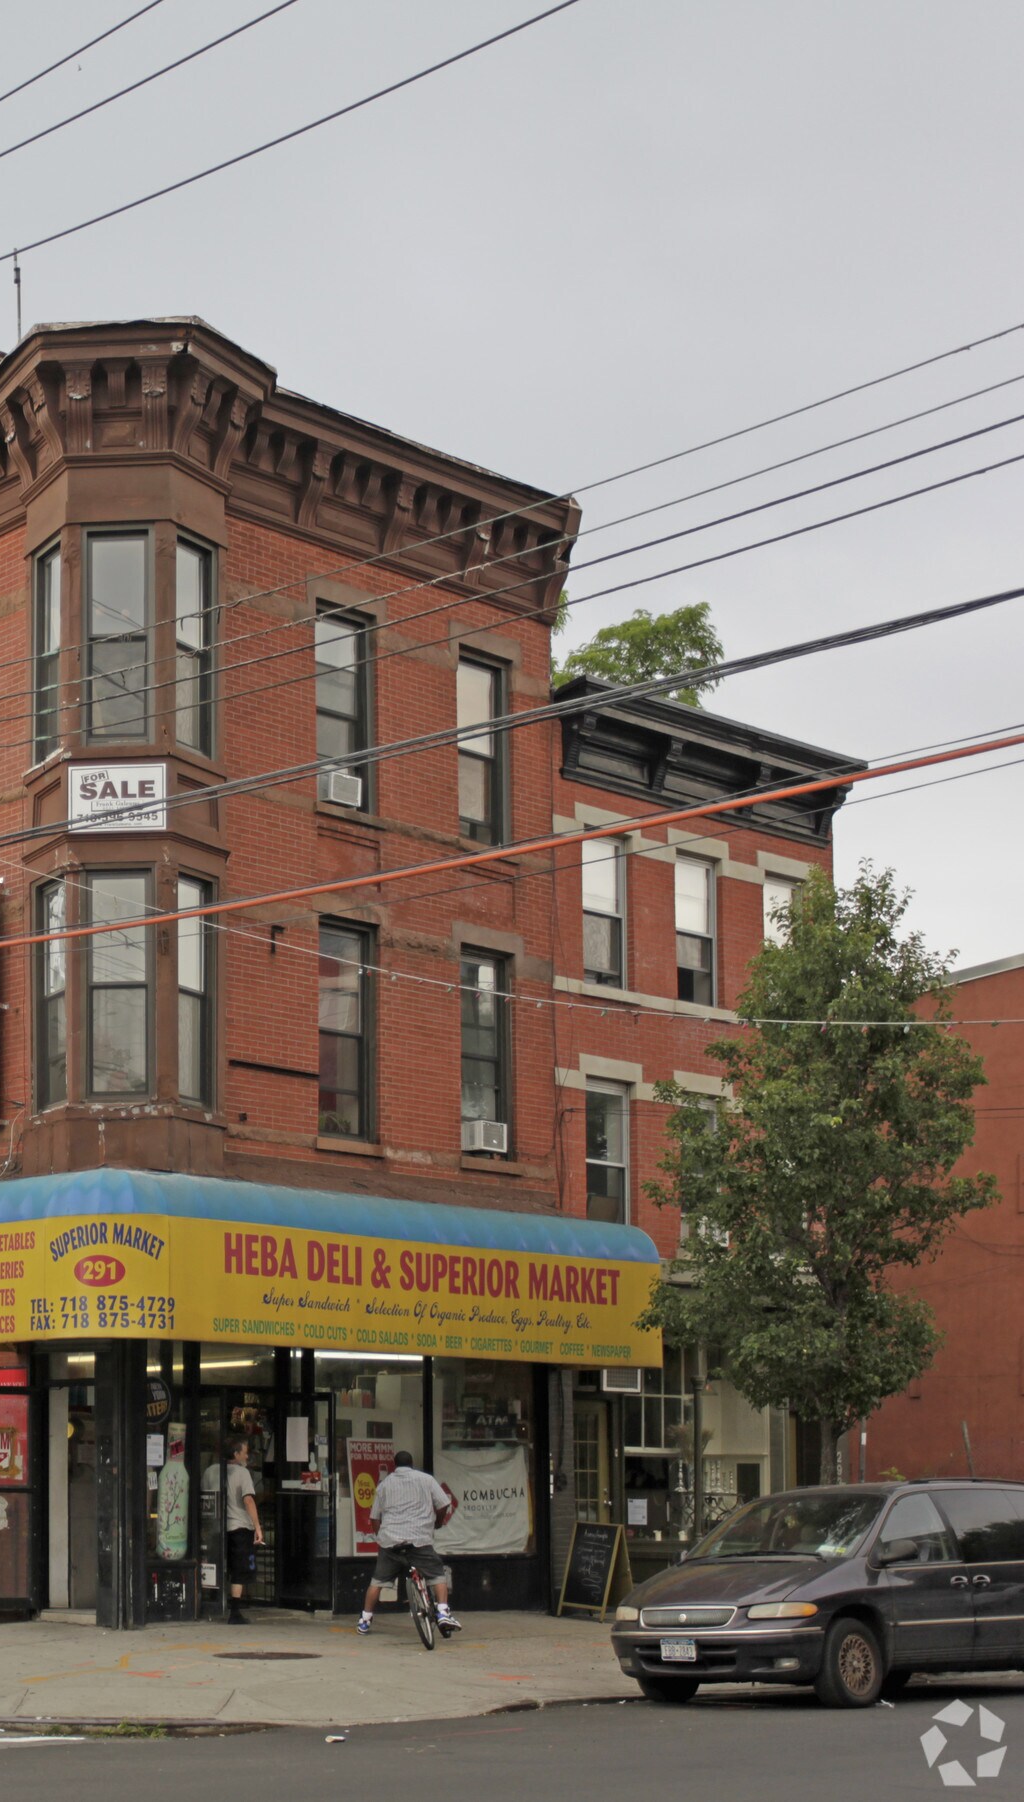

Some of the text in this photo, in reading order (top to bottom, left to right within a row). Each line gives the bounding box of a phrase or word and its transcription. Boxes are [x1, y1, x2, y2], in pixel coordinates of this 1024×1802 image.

[84, 772, 106, 782] FOR
[80, 780, 156, 800] SALE
[50, 1222, 165, 1262] SUPERIOR MARKET
[83, 1260, 116, 1280] 291
[224, 1232, 620, 1306] HEBA DELI & SUPERIOR MARKET
[30, 1295, 175, 1314] TEL: 718 875-4729
[262, 1287, 294, 1312] Super
[298, 1290, 350, 1312] Sandwich
[365, 1299, 410, 1317] Selection
[414, 1300, 426, 1324] Of
[430, 1302, 466, 1326] Organic
[576, 1313, 592, 1329] Etc.
[30, 1312, 175, 1331] FAX: 718 875-4731
[213, 1317, 631, 1359] SUPER SANDWICHES COLD CUTS COLD SALADS SODA BEER CIGARETTES GOURMET COFFEE NEWSPAPER
[476, 1415, 508, 1425] ATM
[350, 1442, 373, 1452] MORE
[463, 1487, 525, 1501] KOMBUCHA
